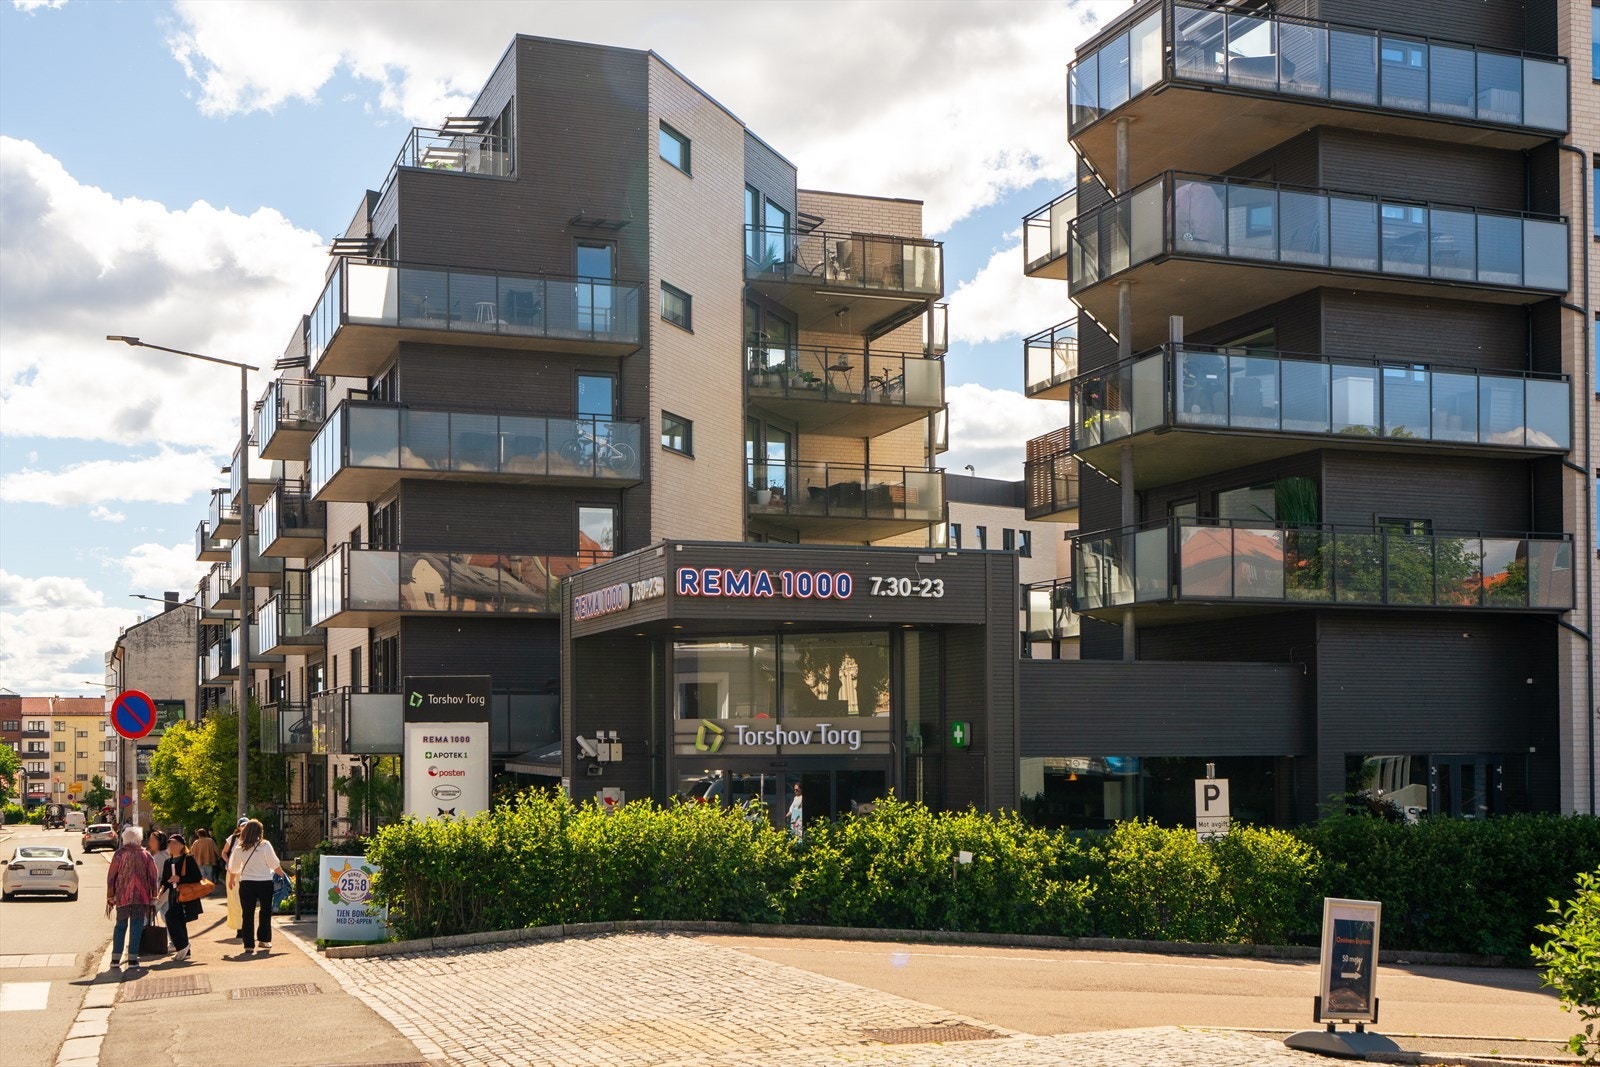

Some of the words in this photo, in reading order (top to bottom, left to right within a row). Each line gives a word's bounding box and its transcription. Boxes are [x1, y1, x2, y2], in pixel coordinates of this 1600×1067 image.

[676, 567, 774, 599] REMA
[779, 569, 854, 600] 1000
[869, 575, 945, 599] 7.30-23
[574, 590, 601, 621] REMA
[602, 582, 630, 614] 1000
[428, 694, 464, 704] Torshov
[466, 694, 485, 706] Torg
[734, 723, 812, 747] Torshov
[816, 723, 862, 750] Torg
[1204, 784, 1220, 811] P
[342, 879, 354, 891] 25
[361, 879, 367, 891] 8
[1342, 954, 1349, 962] 50
